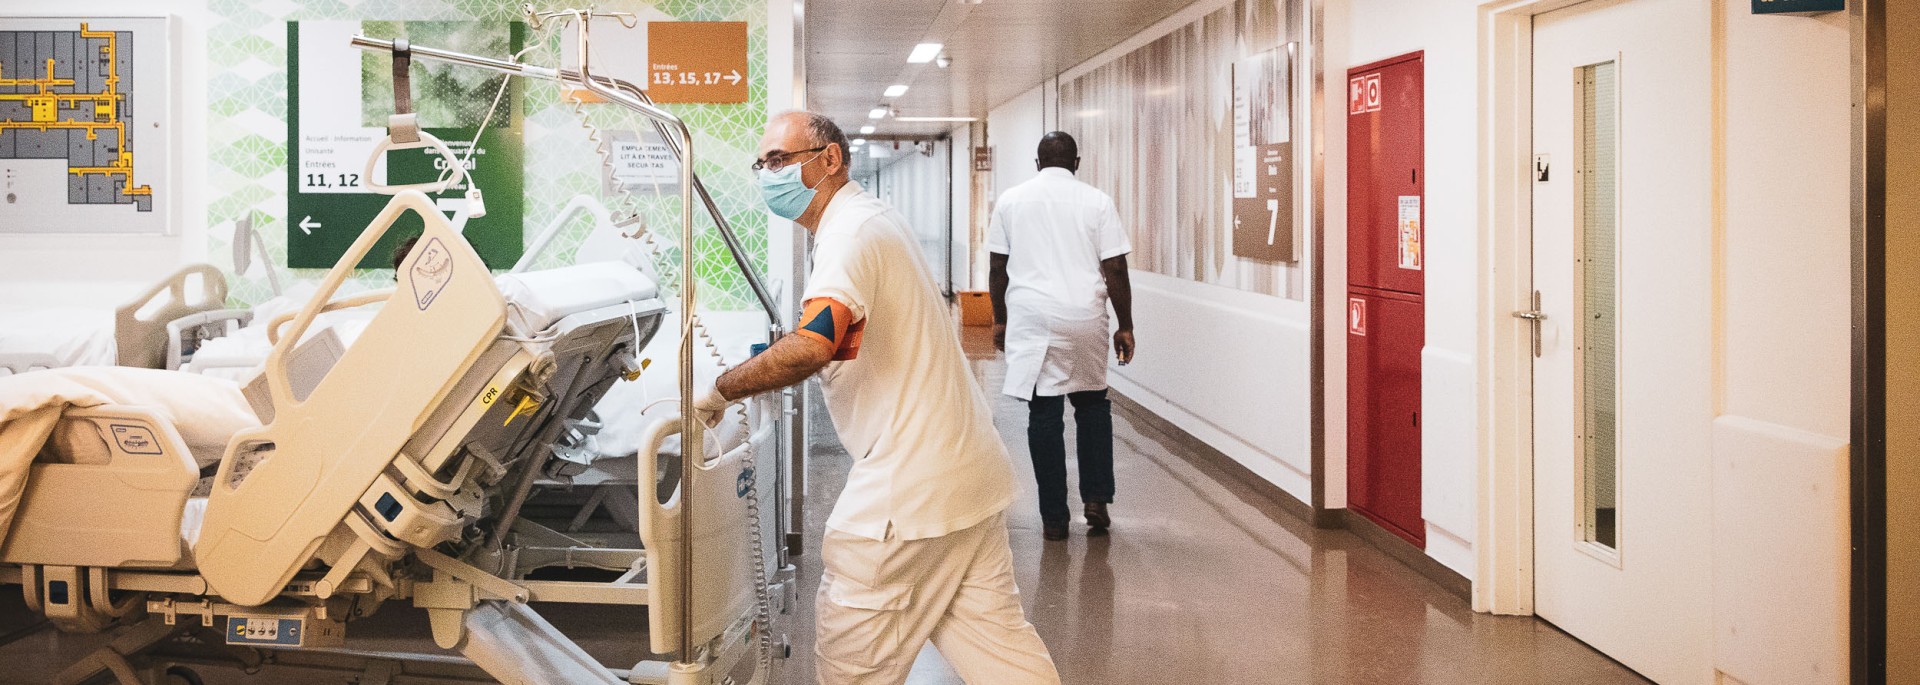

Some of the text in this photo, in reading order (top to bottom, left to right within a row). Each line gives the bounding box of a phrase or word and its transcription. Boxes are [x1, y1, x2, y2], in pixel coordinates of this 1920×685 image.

[652, 63, 678, 71] Entrées
[653, 72, 721, 86] 13, 15, 17
[476, 147, 486, 155] du
[305, 160, 336, 168] Entrées
[433, 157, 476, 170] Cral
[307, 173, 359, 188] 11, 12
[1267, 199, 1278, 246] 7
[482, 387, 498, 404] CPR
